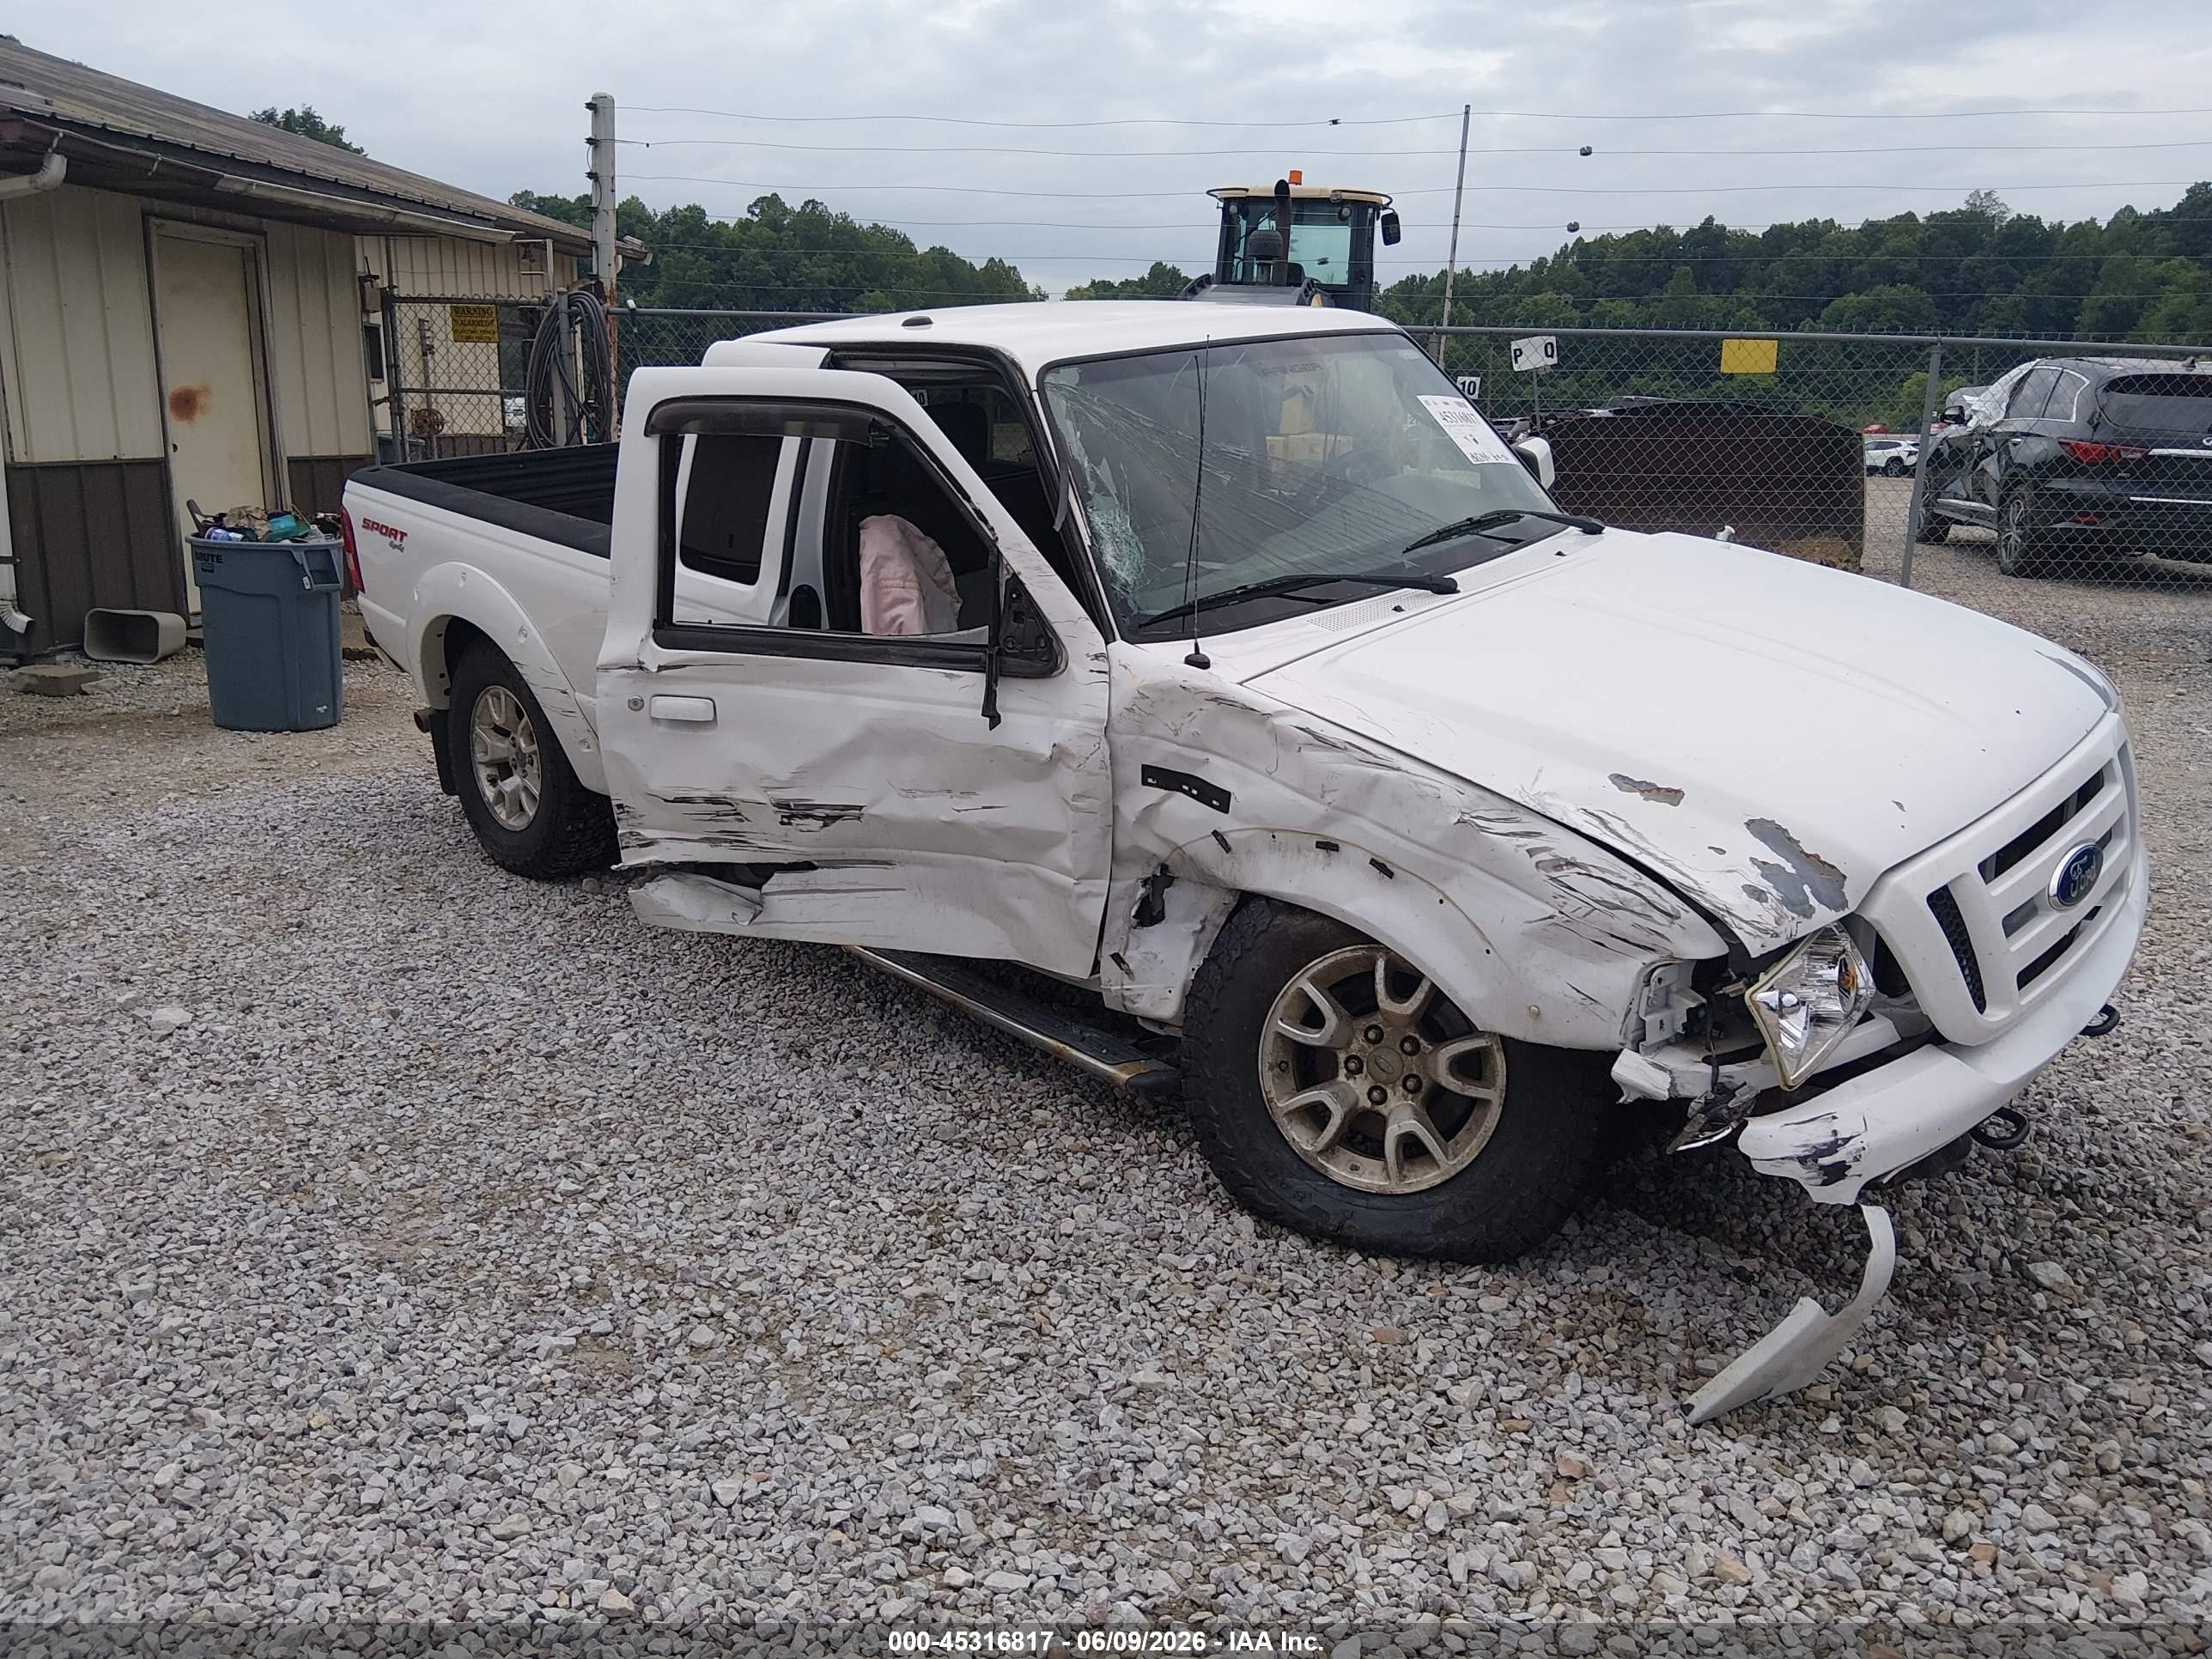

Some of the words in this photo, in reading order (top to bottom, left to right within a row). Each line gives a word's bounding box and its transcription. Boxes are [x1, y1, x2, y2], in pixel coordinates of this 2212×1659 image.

[453, 306, 495, 316] WARNING
[1513, 348, 1523, 364] P
[1544, 342, 1555, 359] Q
[1261, 362, 1320, 379] RANGER
[1460, 380, 1476, 396] 10
[362, 517, 408, 543] SPORT
[194, 550, 223, 564] BRUTE
[2069, 854, 2096, 897] Ford
